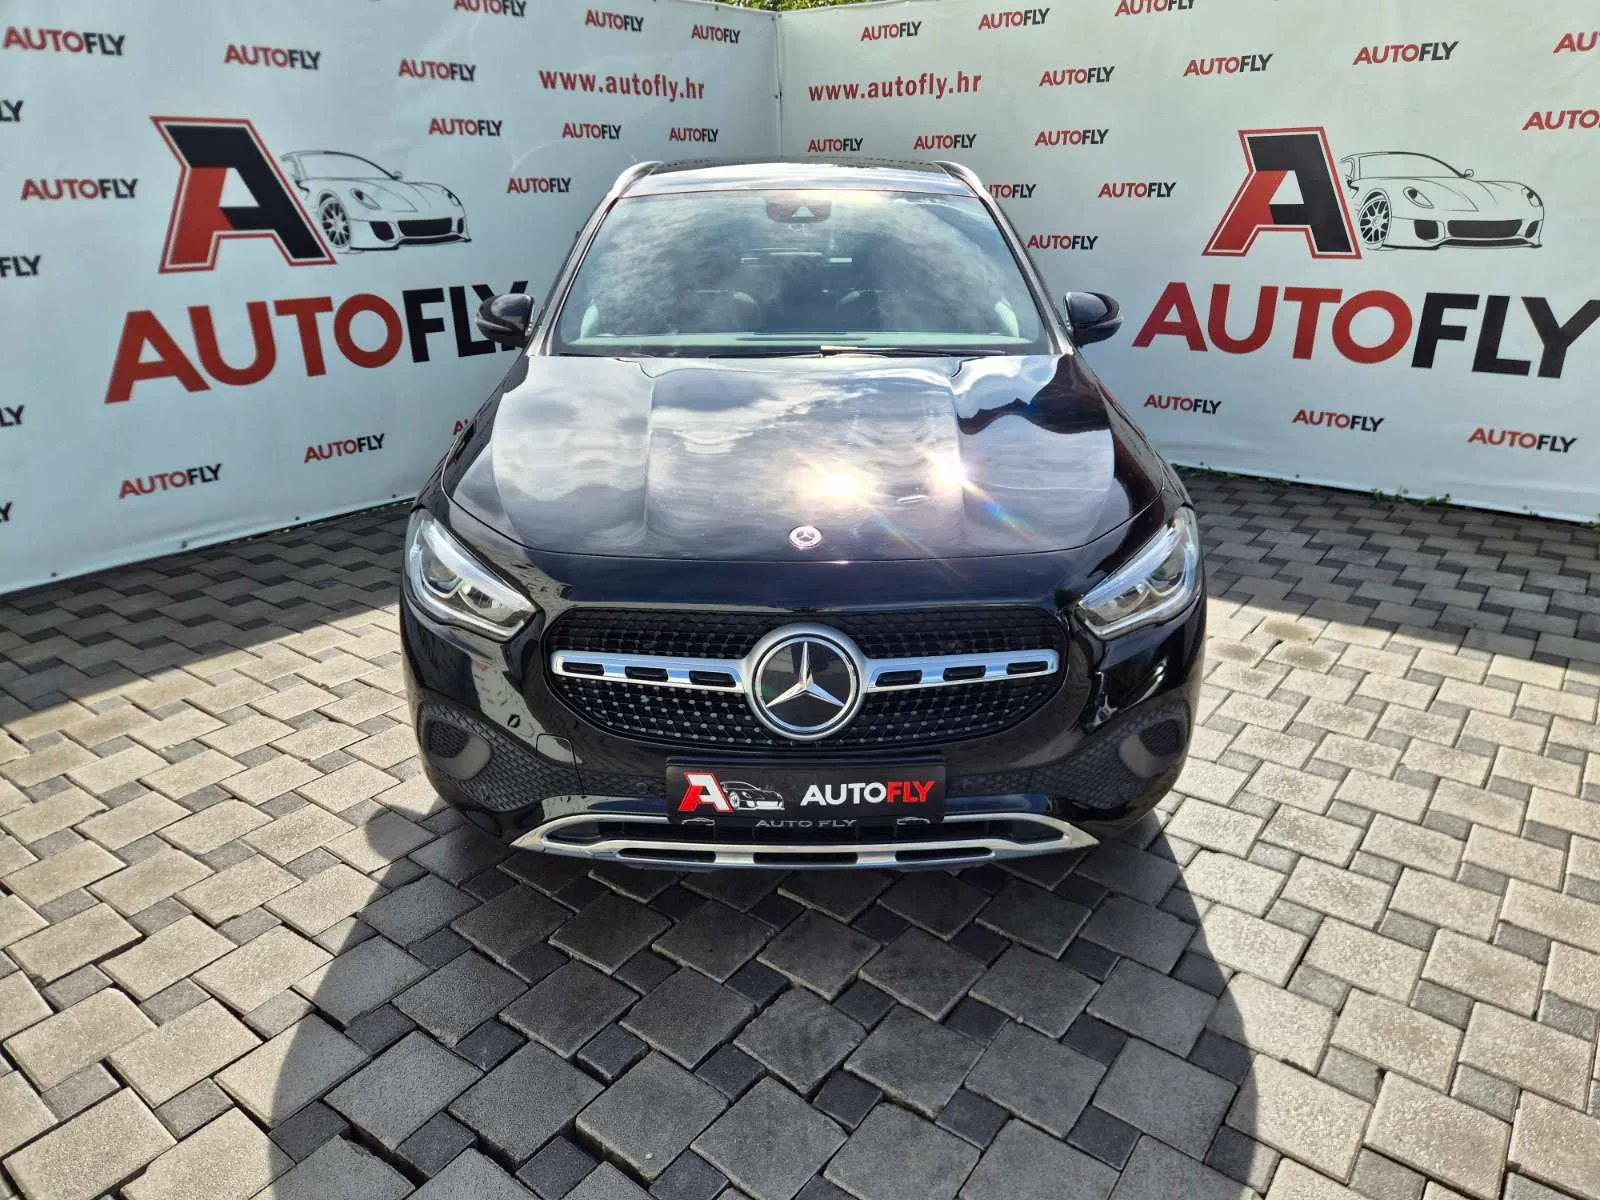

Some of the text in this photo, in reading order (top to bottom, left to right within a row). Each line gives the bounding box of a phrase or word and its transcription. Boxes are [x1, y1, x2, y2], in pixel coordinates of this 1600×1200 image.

[455, 0, 526, 17] AUTOFLY
[978, 8, 1050, 30] AUTOFLY
[585, 10, 644, 32] AUTOFLY
[861, 21, 922, 41] AUTOFLY
[4, 28, 125, 56] AUTOFLY
[691, 24, 741, 44] AUTOFLY
[225, 45, 321, 70] AUTOFLY
[1352, 41, 1459, 65] AUTOFLY
[399, 60, 476, 82] AUTOFLY
[1039, 66, 1115, 86] AUTOFLY
[1183, 54, 1273, 77] AUTOFLY
[539, 71, 704, 103] www.autofly.hr
[809, 71, 981, 101] www.autofly.hr
[429, 118, 502, 136] AUTOFLY
[562, 123, 621, 140] AUTOFLY
[670, 128, 718, 142] AUTOFLY
[1035, 129, 1109, 146] AUTOFLY
[808, 138, 863, 152] AUTOFLY
[914, 134, 976, 150] AUTOFLY
[21, 178, 138, 200] AUTOFLY
[507, 178, 571, 193] AUTOFLY
[1098, 182, 1176, 198] AUTOFLY
[1027, 235, 1098, 250] AUTOFLY
[1132, 282, 1600, 379] AUTOFLY
[1144, 395, 1221, 414] AUTOFLY
[1293, 410, 1384, 432] AUTOFLY
[305, 433, 384, 463] AUTOFLY
[1468, 428, 1577, 453] AUTOFLY
[120, 464, 221, 498] AUTOFLY
[800, 781, 935, 806] AUTOFLY
[755, 819, 857, 828] AUTO FLY
